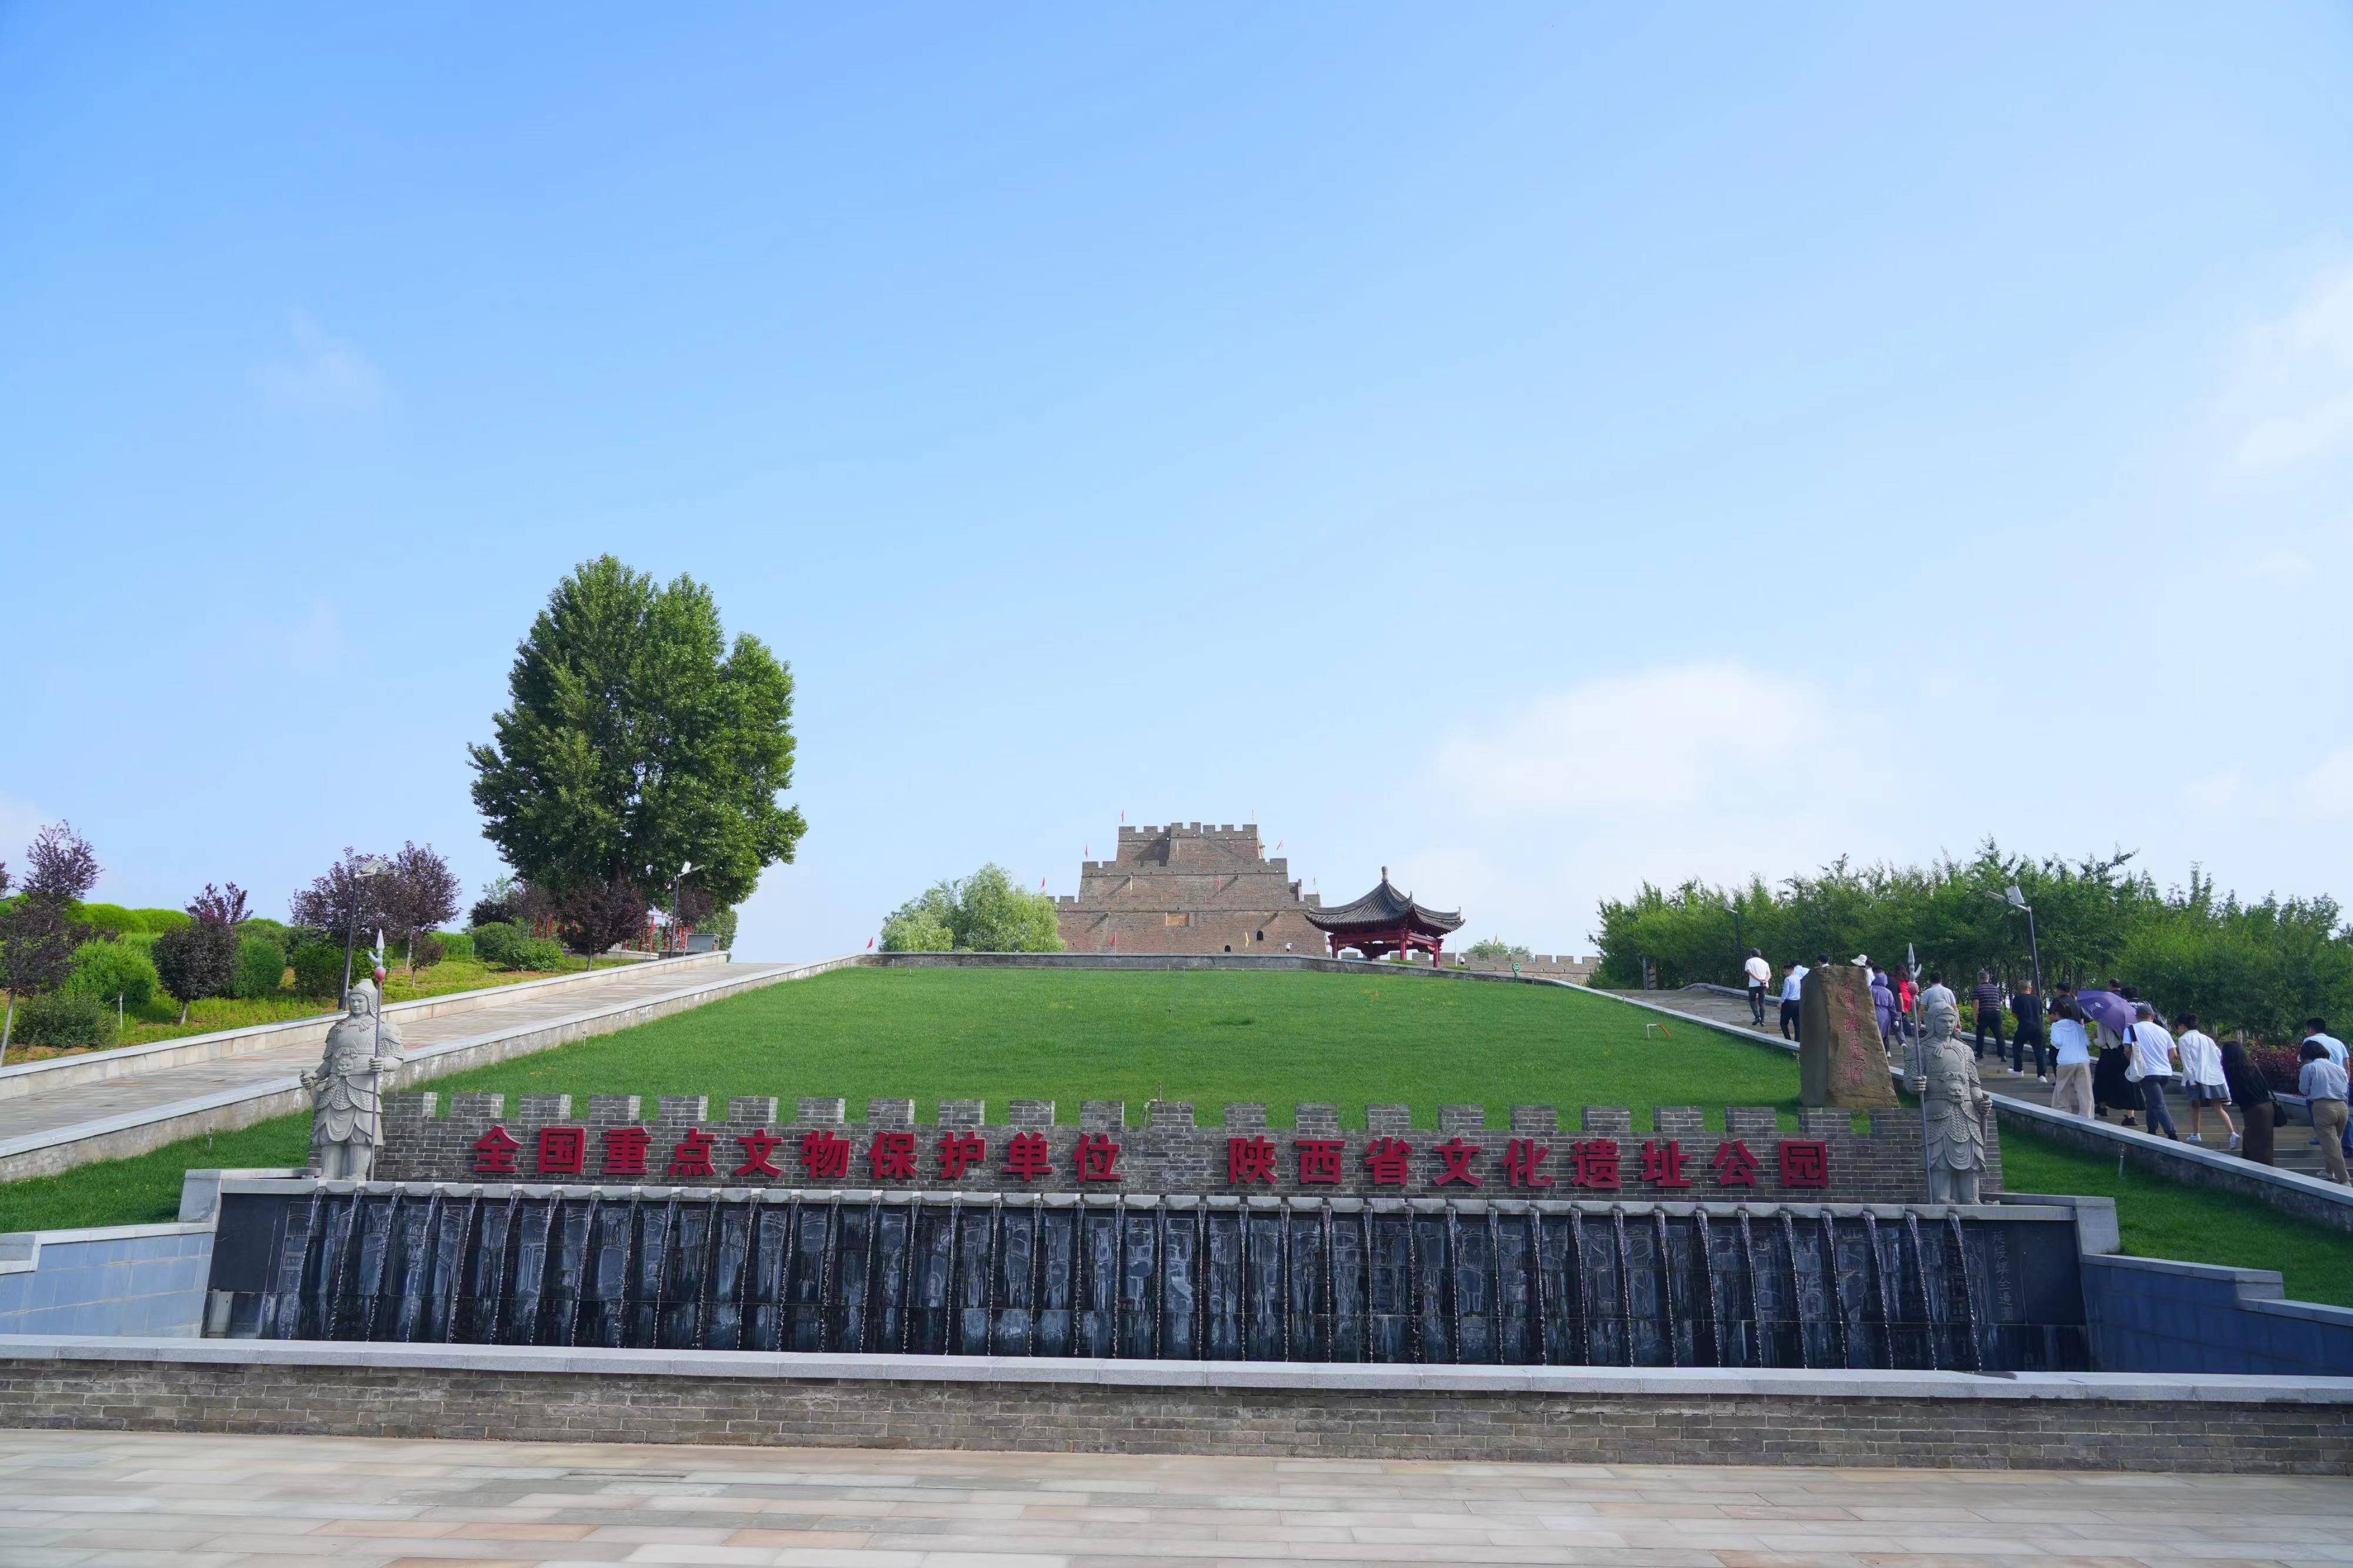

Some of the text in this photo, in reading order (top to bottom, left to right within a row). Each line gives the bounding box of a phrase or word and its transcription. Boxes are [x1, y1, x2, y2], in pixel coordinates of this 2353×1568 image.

[473, 1125, 1829, 1189] 全国重点文物保护单位 陕西省文化遗址公园
